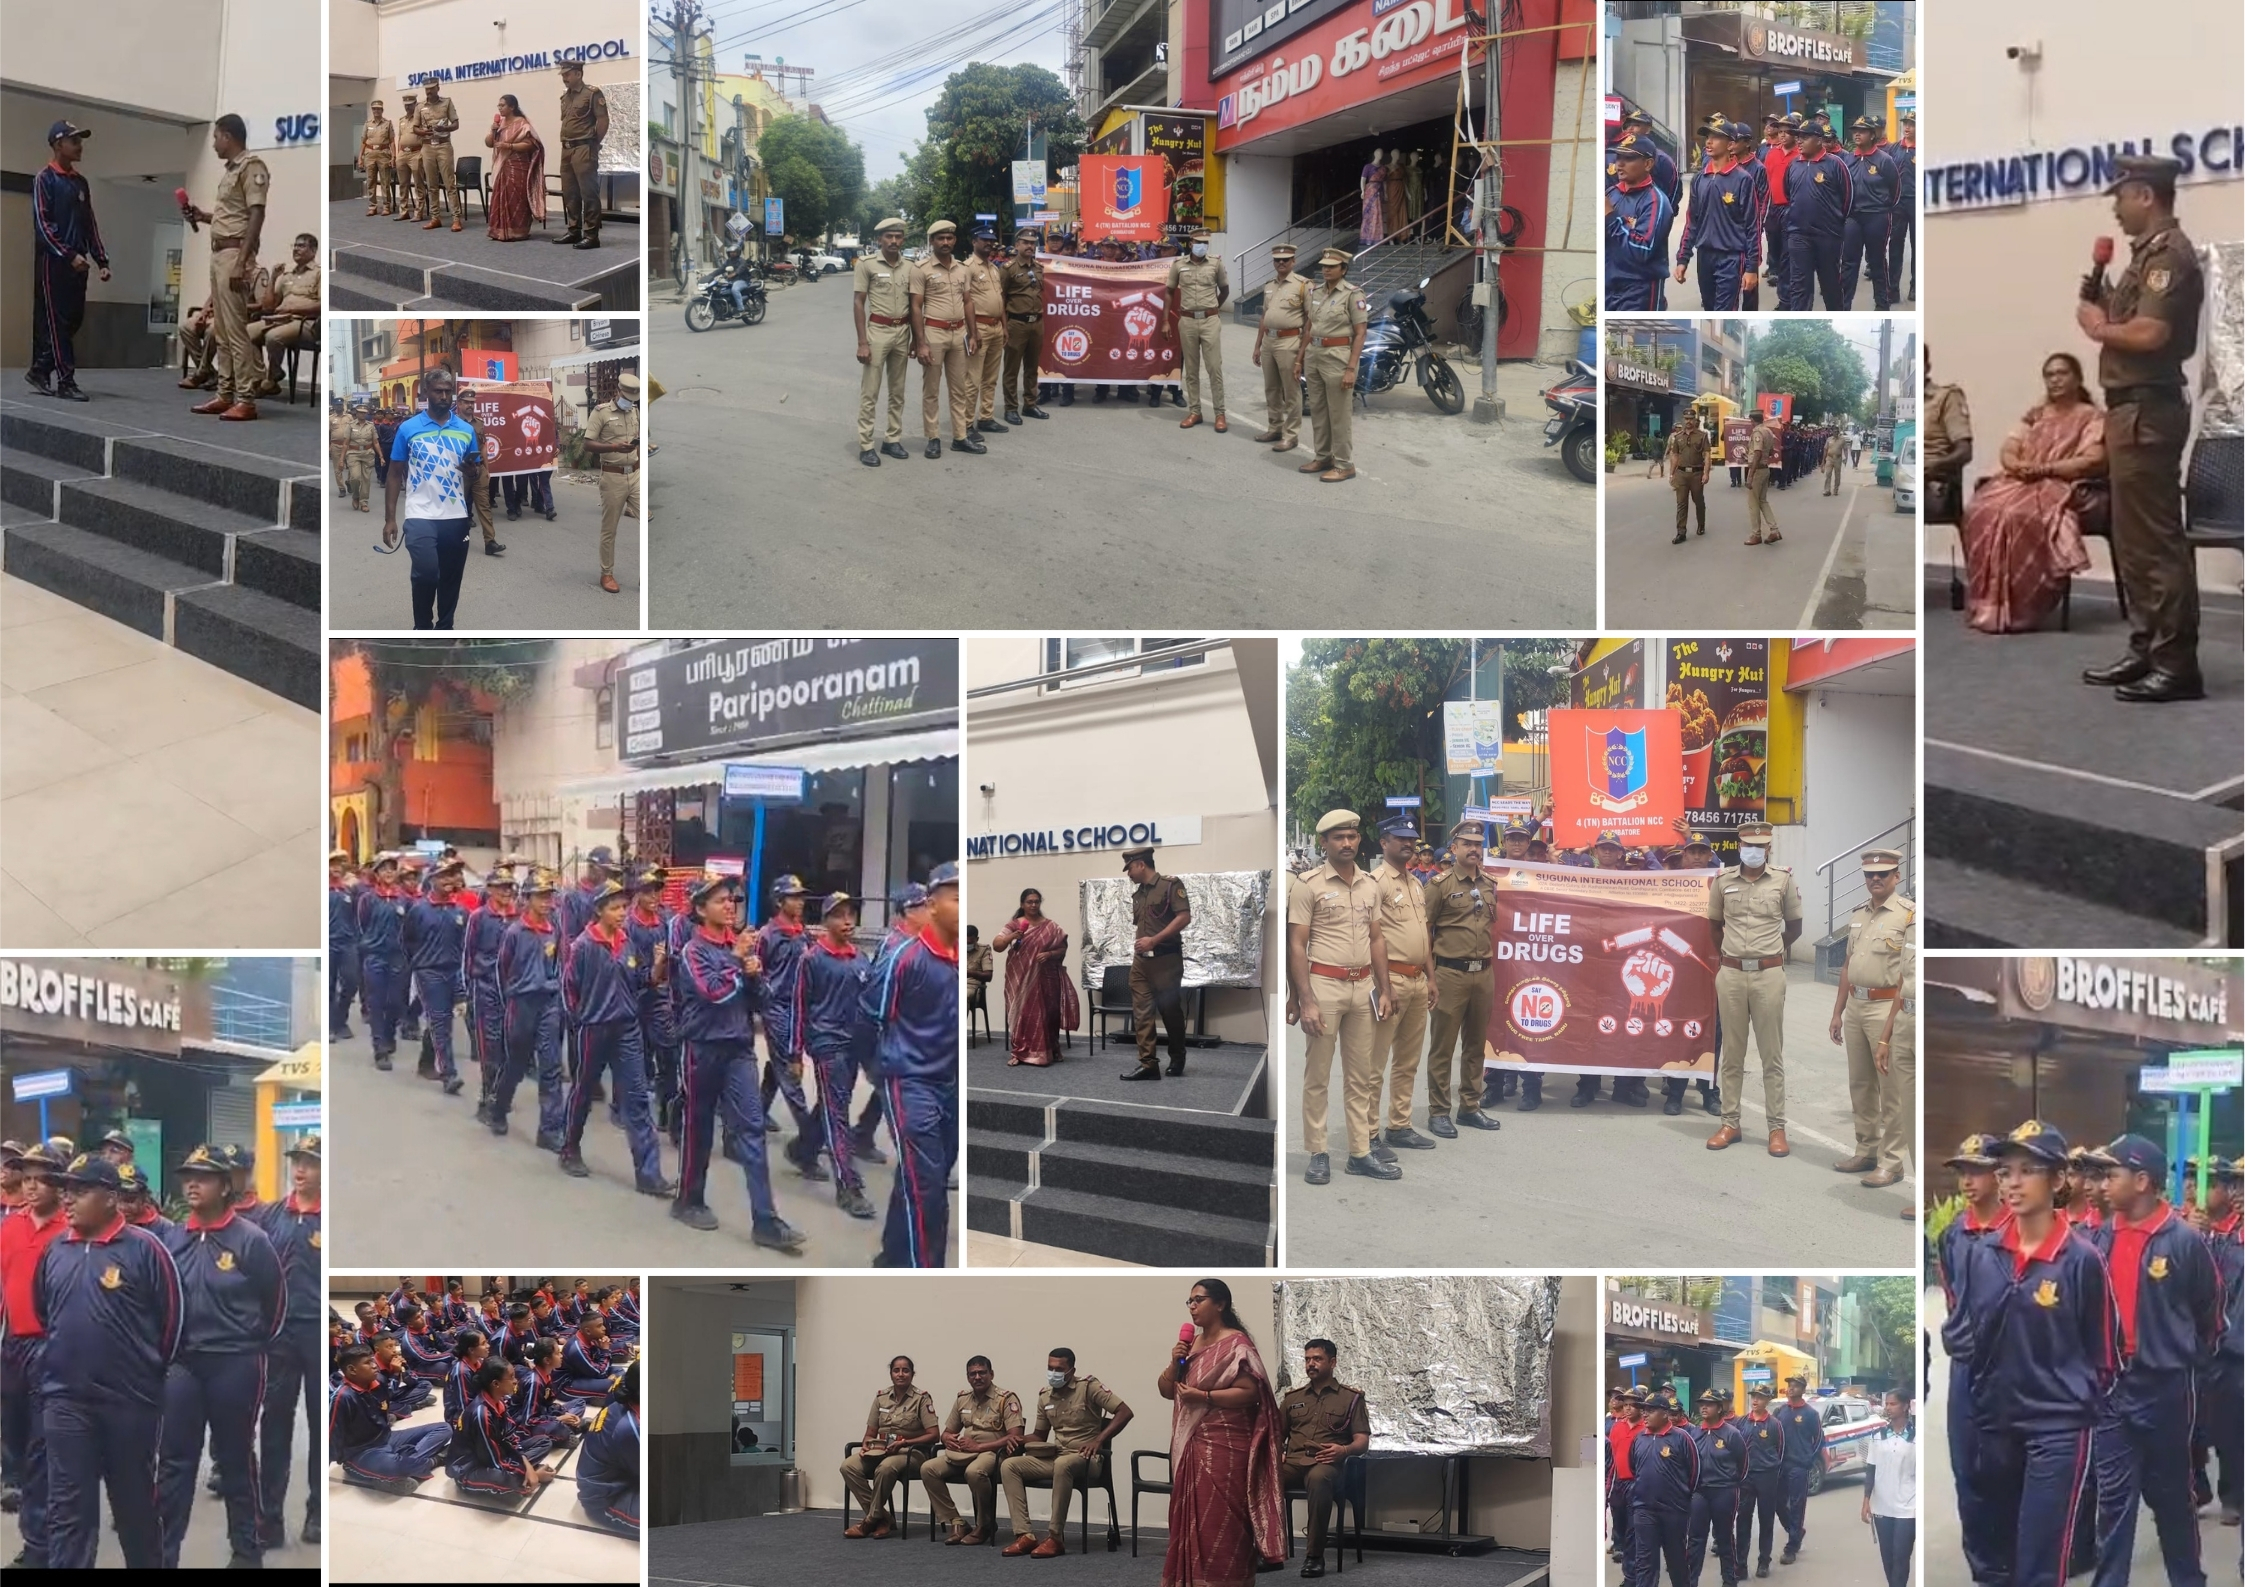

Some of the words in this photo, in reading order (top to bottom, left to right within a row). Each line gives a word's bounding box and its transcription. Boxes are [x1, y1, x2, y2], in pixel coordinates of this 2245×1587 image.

[1270, 9, 1280, 20] SPA
[1248, 23, 1258, 34] HAIR
[1767, 29, 1832, 62] BROFFLES
[1833, 47, 1852, 64] CAFÉ
[455, 51, 551, 80] INTERNATIONAL
[553, 38, 630, 64] SCHOOL
[1237, 53, 1323, 131] நம்ம
[1331, 0, 1467, 77] கடை
[276, 113, 321, 142] SUG
[1148, 124, 1164, 136] The
[1151, 137, 1185, 149] Hungry
[1186, 139, 1202, 149] Hut
[1924, 138, 2151, 206] TERNATION
[1055, 285, 1092, 299] LIFE
[1047, 303, 1101, 317] DRUGS
[1061, 336, 1083, 352] NO
[1617, 363, 1658, 387] BROFFLES
[474, 402, 500, 413] LIFE
[483, 416, 507, 426] UGS
[1673, 641, 1699, 660] The
[1679, 661, 1734, 684] Hungry
[1737, 666, 1765, 684] Hut
[709, 655, 921, 723] Paripooranam
[841, 686, 920, 720] Chettinad
[1608, 756, 1628, 769] NCC
[1575, 818, 1582, 828] 4
[1583, 818, 1600, 830] (TN)
[1601, 817, 1645, 827] BATTALION
[1647, 816, 1664, 826] NCC
[1684, 810, 1721, 824] 78456
[1723, 813, 1758, 824] 71755
[967, 829, 1059, 858] NATIONAL
[1062, 822, 1162, 850] SCHOOL
[1536, 873, 1578, 884] SUGUNA
[1580, 877, 1659, 888] INTERNATIONAL
[1661, 878, 1704, 889] SCHOOL
[1513, 911, 1572, 935] LIFE
[1528, 934, 1555, 943] OVER
[1497, 941, 1584, 964] DRUGS
[0, 959, 138, 1028] BROFFLES
[139, 996, 181, 1032] CAFÉ
[1531, 986, 1542, 994] SAY
[2057, 957, 2188, 1021] BROFFLES
[2188, 990, 2227, 1025] CAFÉ
[1521, 994, 1554, 1019] NO
[1505, 1020, 1519, 1035] DRUG
[1518, 1032, 1534, 1042] FREE
[1534, 1035, 1554, 1043] TAMIL
[1553, 1022, 1568, 1037] NADU
[1521, 1018, 1530, 1027] TO
[1531, 1019, 1552, 1028] DRUGS
[281, 1060, 311, 1075] TVS
[1612, 1300, 1679, 1334] BROFFLES
[1679, 1318, 1699, 1335] CAFÉ
